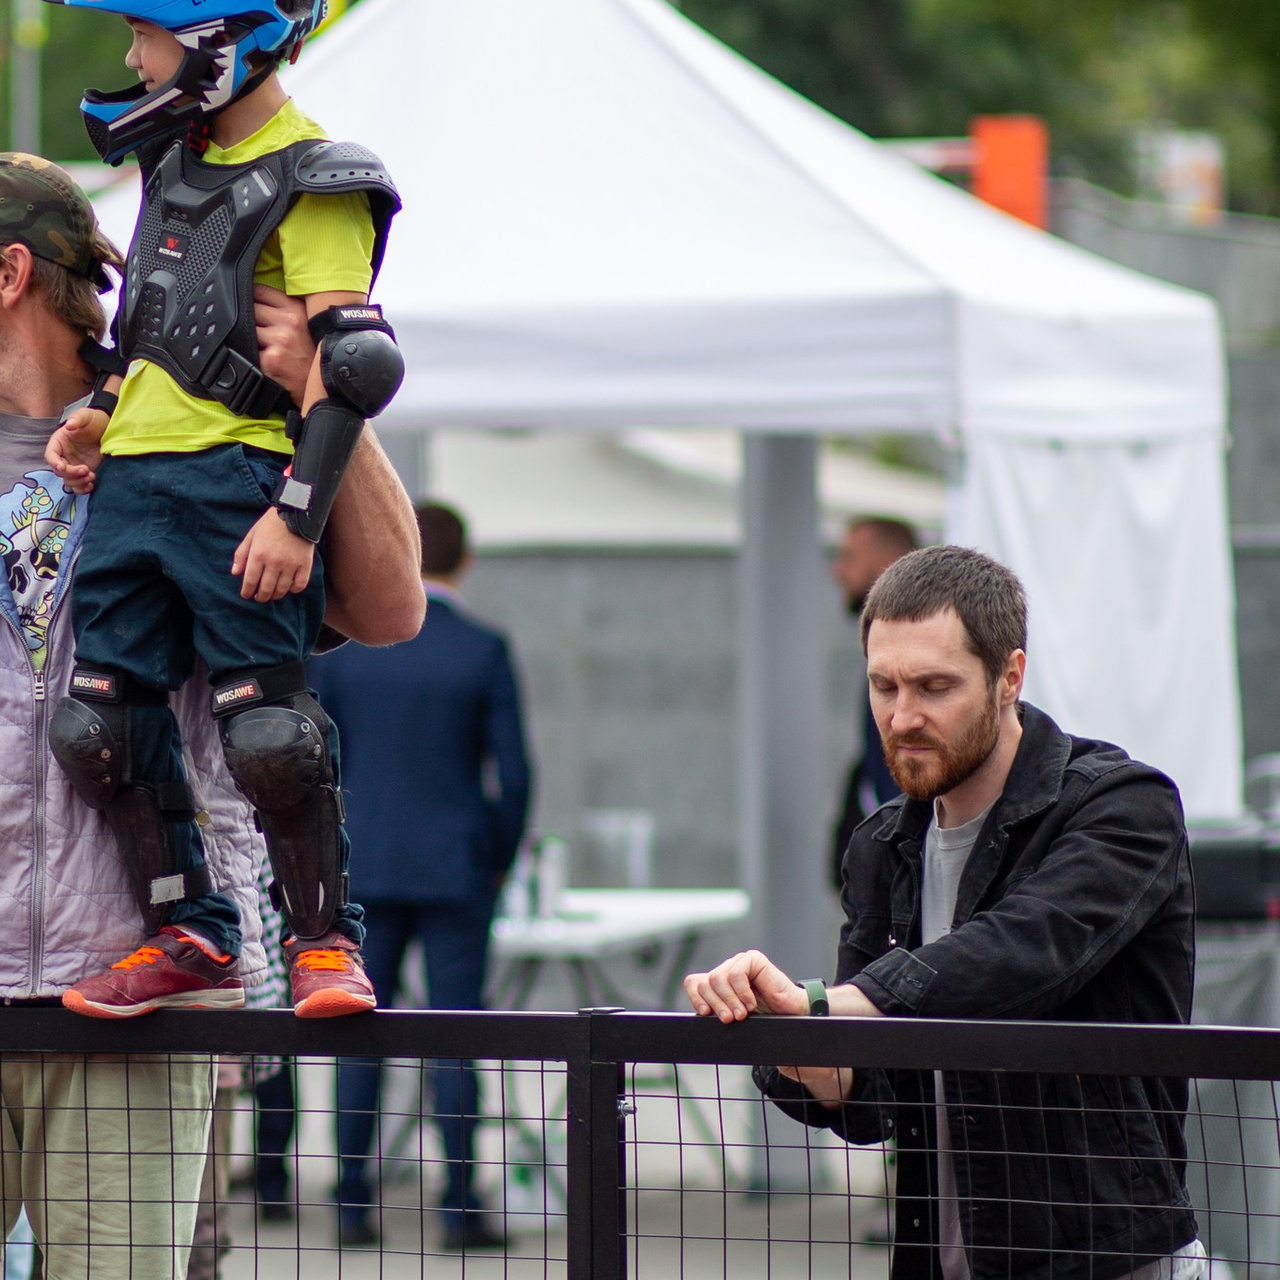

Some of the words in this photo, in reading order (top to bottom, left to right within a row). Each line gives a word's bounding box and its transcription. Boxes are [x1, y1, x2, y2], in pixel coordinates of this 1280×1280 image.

[340, 309, 380, 320] WOSAWE
[73, 676, 110, 691] WOSAWE
[216, 684, 255, 704] WOSAWE
